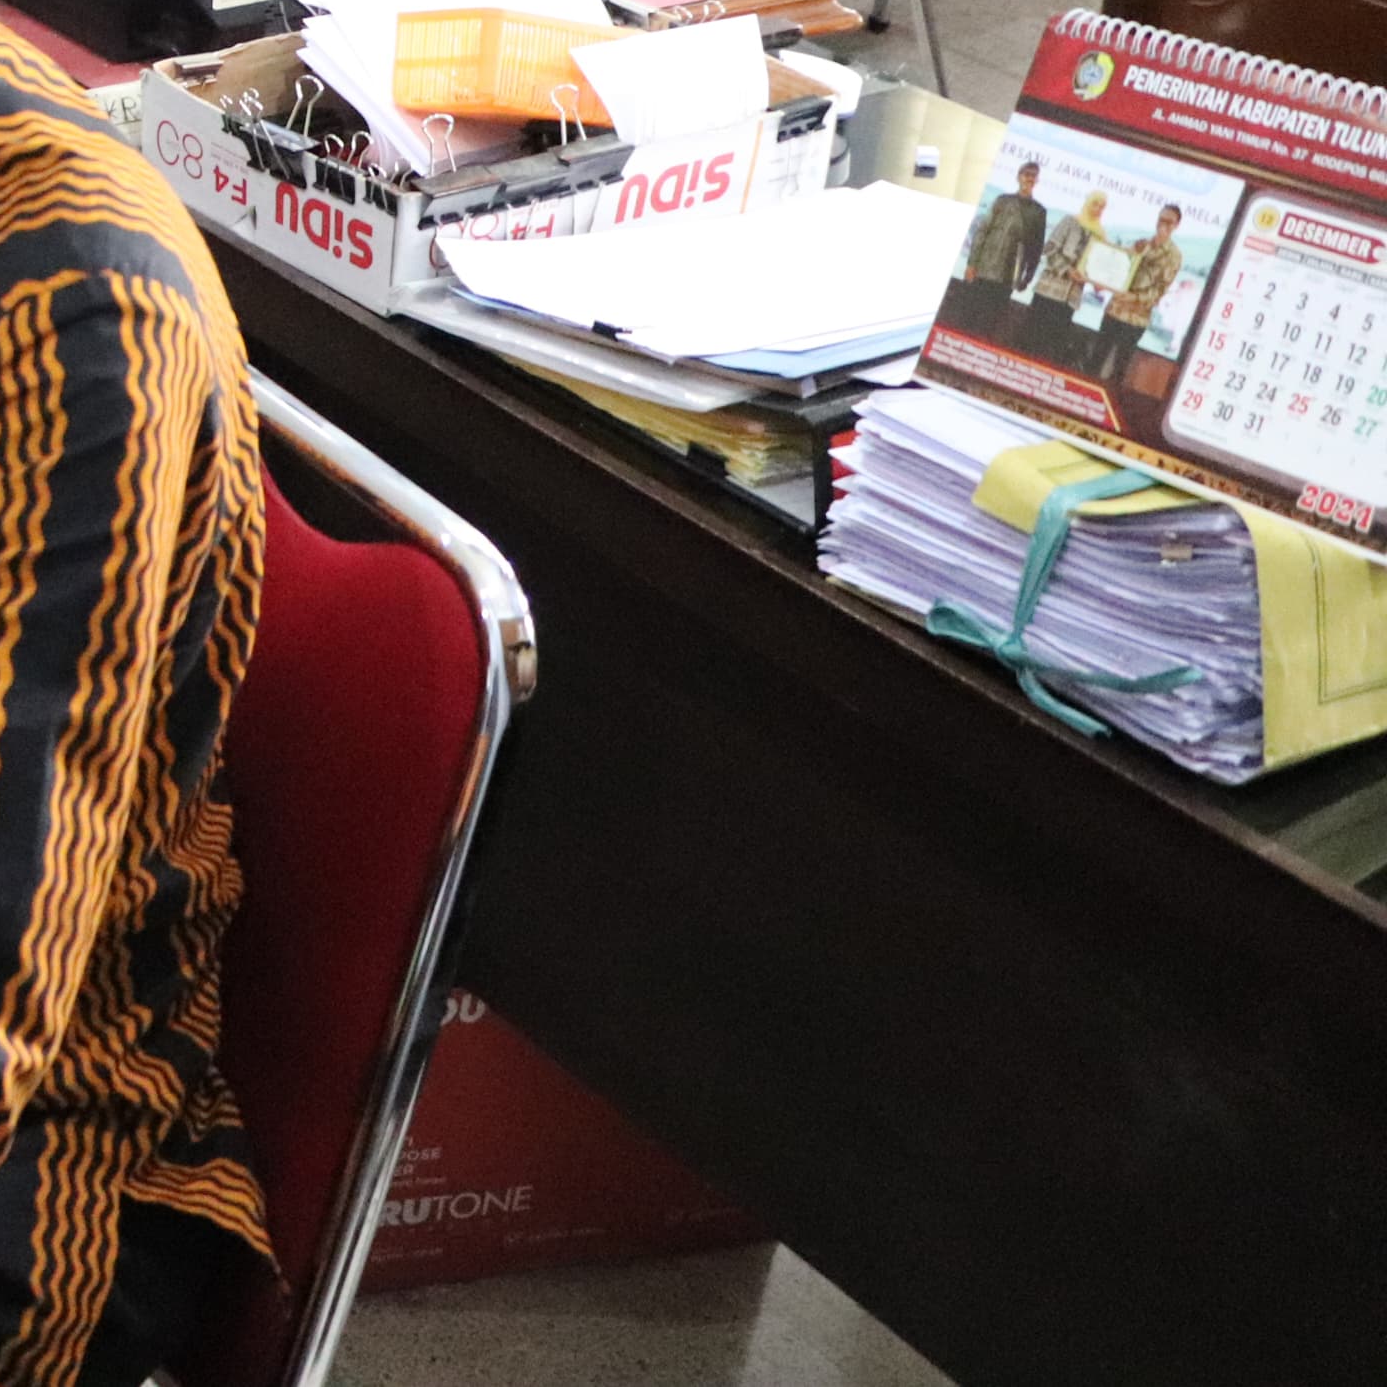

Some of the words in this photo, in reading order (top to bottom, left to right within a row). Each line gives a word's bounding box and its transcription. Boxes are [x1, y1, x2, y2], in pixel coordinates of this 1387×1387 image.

[1123, 65, 1229, 114] PEMERINTAH
[1228, 94, 1330, 143] KABUPATEN
[1168, 111, 1208, 133] AHMAD
[1210, 123, 1234, 139] YANI
[1236, 130, 1271, 151] TIMUR
[213, 165, 248, 206] F4
[1282, 215, 1372, 260] DESEMBER
[1235, 271, 1244, 290] 1
[1263, 282, 1276, 301] 2
[1296, 292, 1309, 311] 3
[1329, 303, 1341, 321] 4
[1362, 313, 1375, 332] 5
[1221, 301, 1234, 319] 8
[1254, 312, 1265, 330] 9
[1282, 321, 1302, 342] 10
[1315, 331, 1333, 353] 11
[1347, 342, 1368, 365] 12
[1193, 360, 1215, 381] 22
[1224, 370, 1247, 392] 23
[1256, 381, 1278, 403] 24
[1287, 392, 1310, 415] 25
[1320, 404, 1342, 426] 26
[1354, 415, 1378, 438] 27
[1208, 330, 1226, 351] 15
[1238, 341, 1257, 362] 16
[1270, 351, 1291, 372] 17
[1302, 363, 1322, 384] 18
[1335, 374, 1356, 395] 19
[1367, 384, 1387, 407] 20
[1181, 389, 1204, 411] 29
[1212, 400, 1235, 422] 30
[1244, 412, 1265, 434] 31
